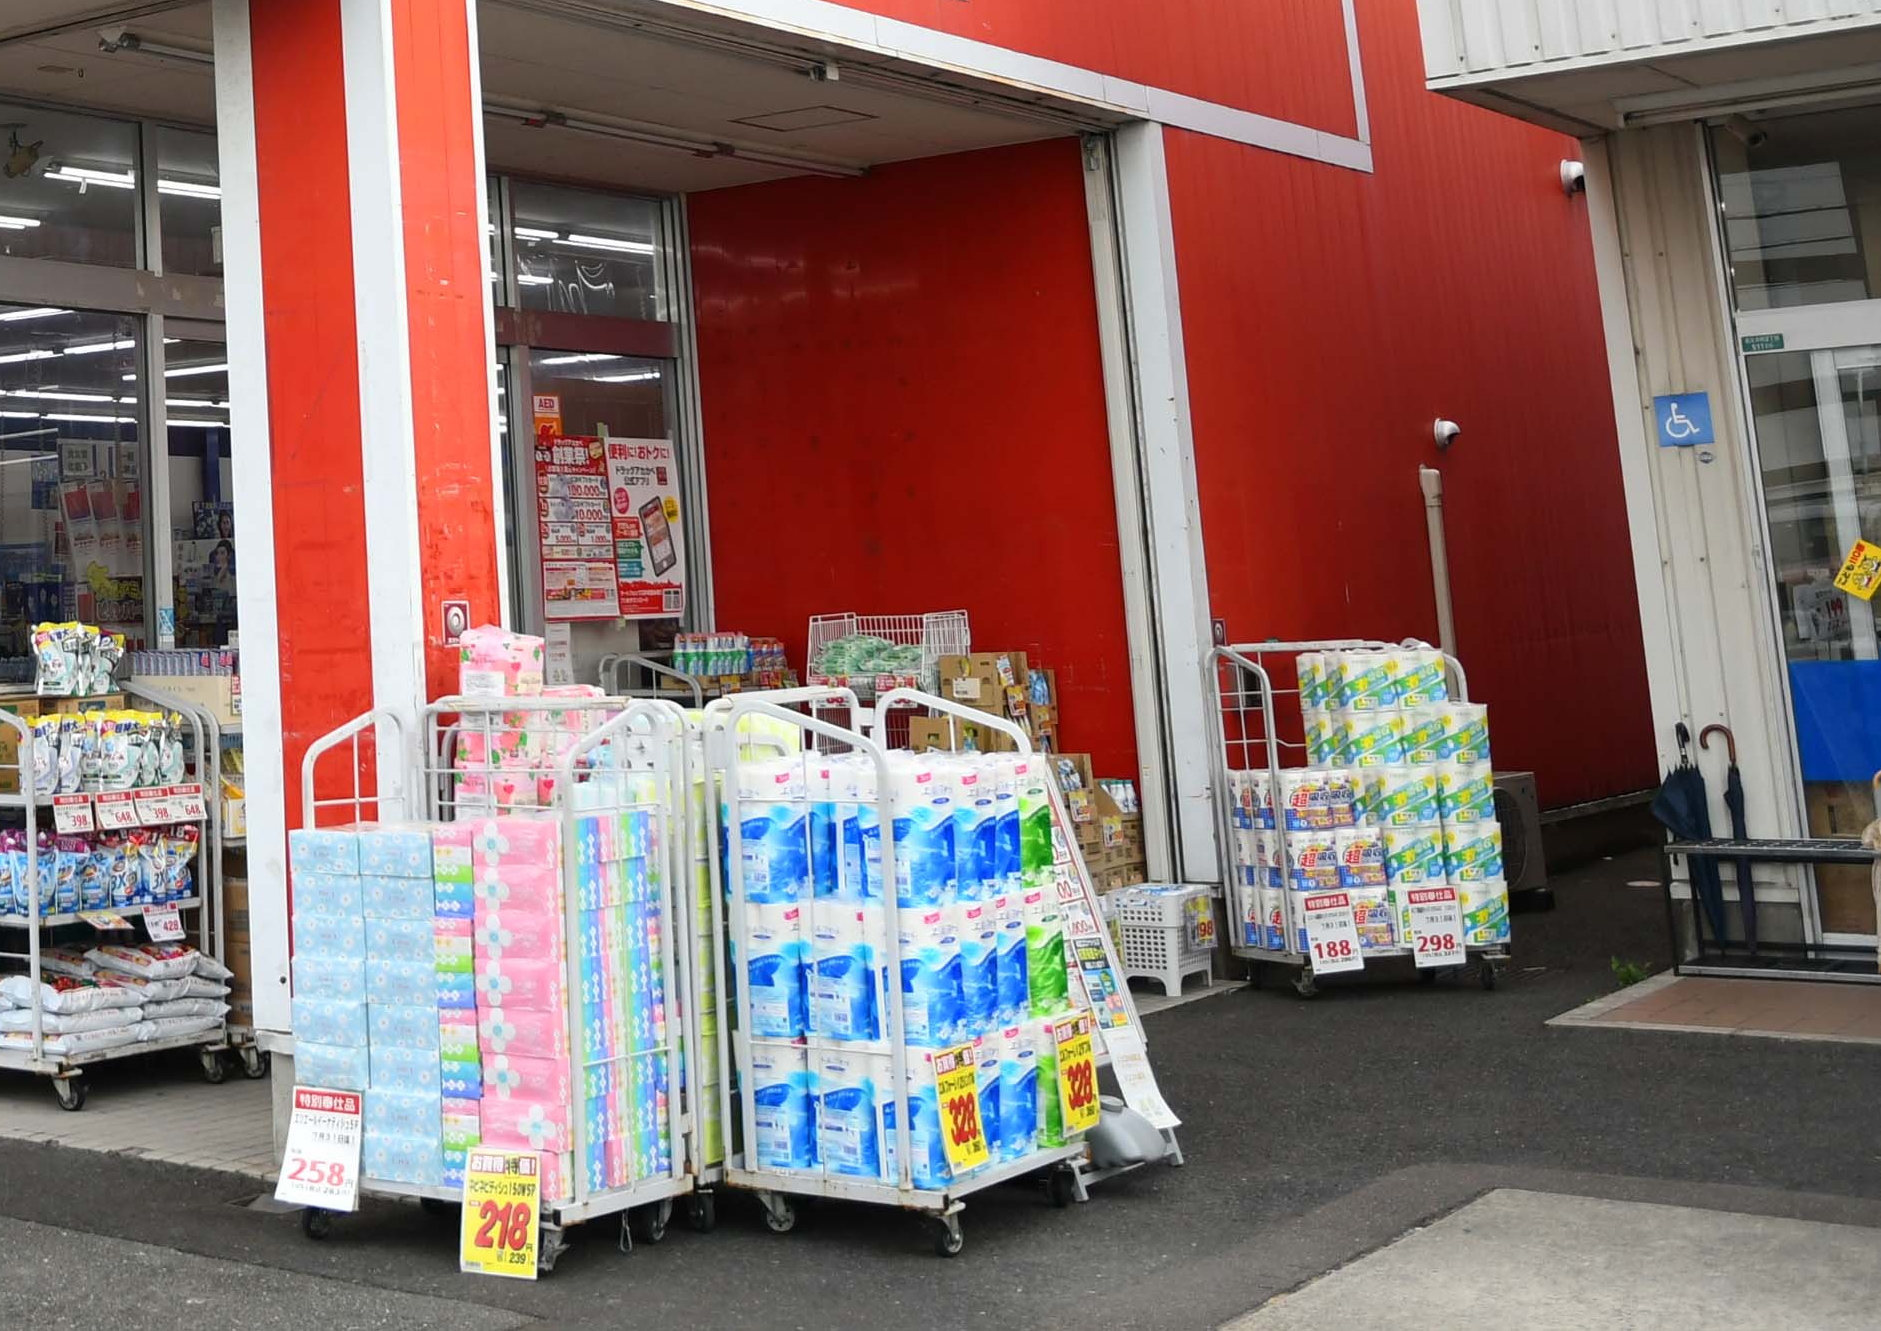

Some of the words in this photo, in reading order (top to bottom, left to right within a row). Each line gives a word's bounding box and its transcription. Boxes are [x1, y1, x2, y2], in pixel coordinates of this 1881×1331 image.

[539, 399, 555, 409] AED
[299, 1093, 356, 1112] 特別奉仕品
[1067, 1059, 1094, 1111] 328
[949, 1091, 977, 1147] 328
[474, 1199, 531, 1251] 218
